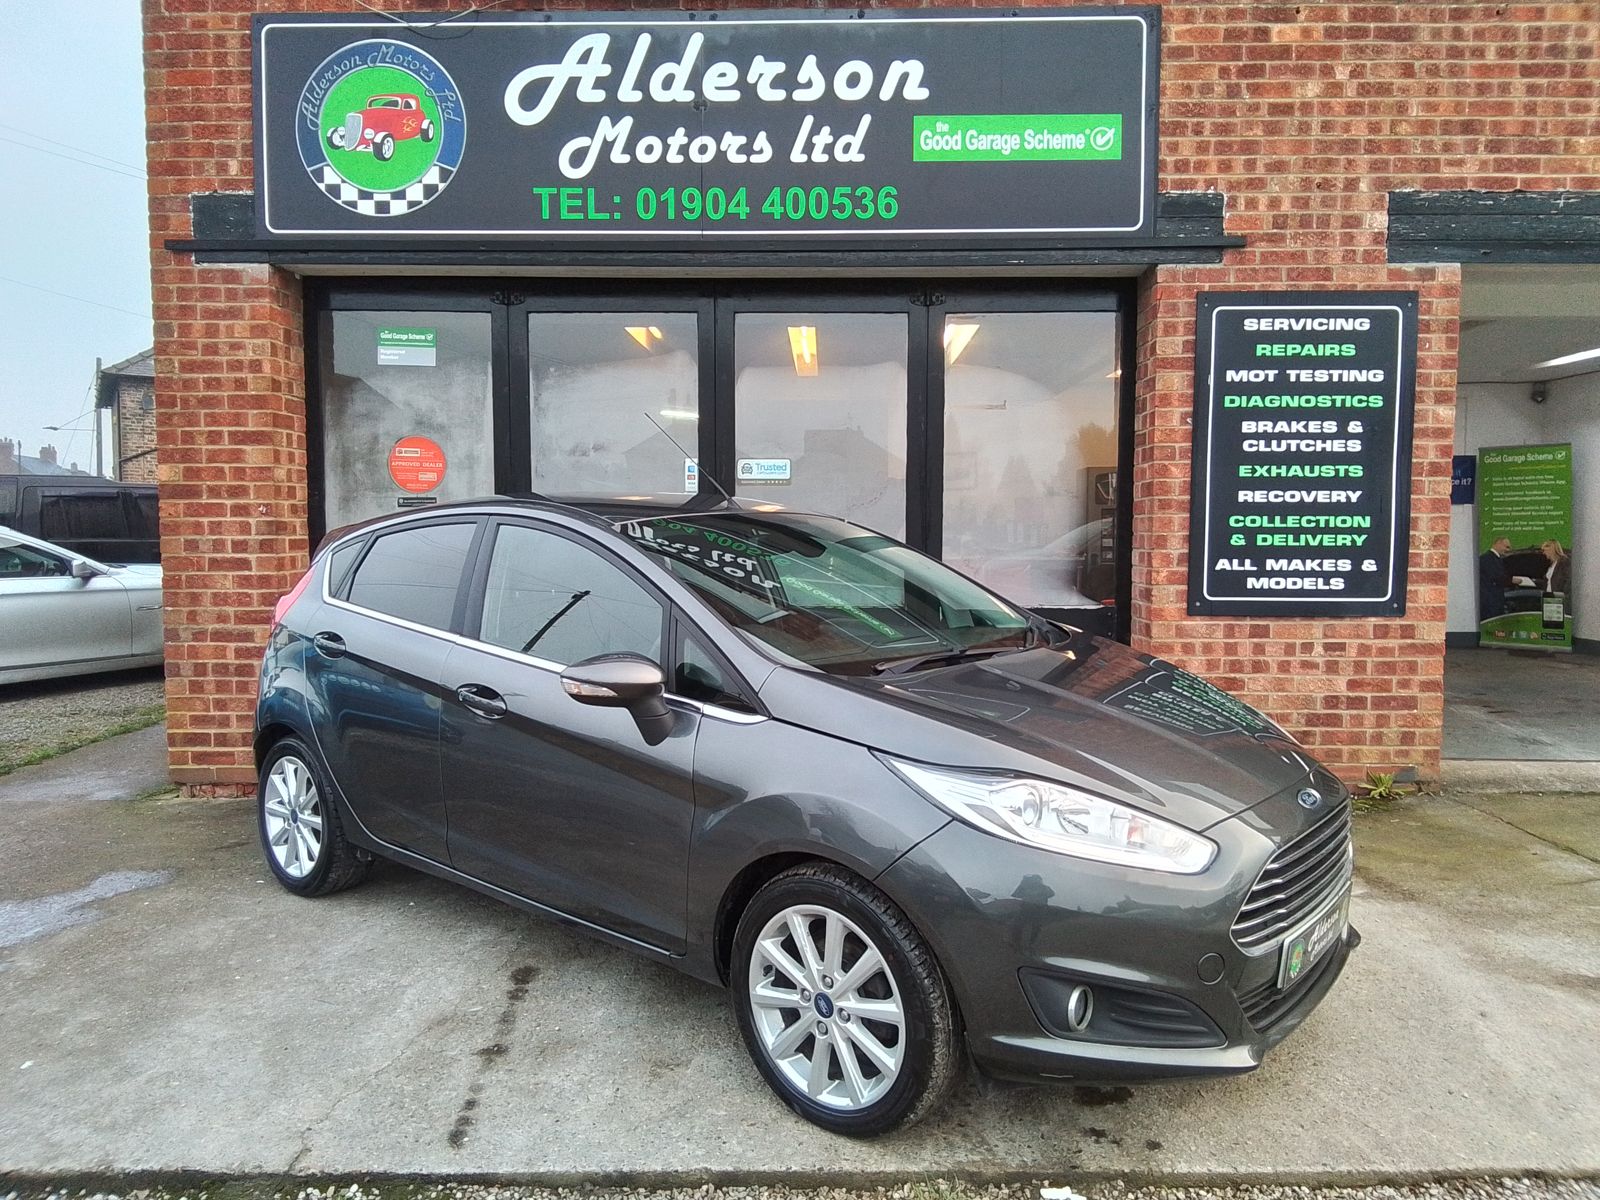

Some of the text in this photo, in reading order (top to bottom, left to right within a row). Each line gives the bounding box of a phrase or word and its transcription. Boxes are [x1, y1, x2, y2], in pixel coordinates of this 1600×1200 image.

[504, 32, 930, 126] Alderson
[301, 55, 362, 131] Alderson
[367, 44, 435, 81] Motors
[935, 121, 950, 132] the
[558, 115, 773, 179] Motors
[919, 128, 1086, 156] Good Garage Scheme
[532, 185, 899, 222] TEL: 01904 400536
[1243, 317, 1371, 331] SERVICING
[1255, 343, 1357, 357] REPAIRS
[1225, 369, 1385, 383] MOT TESTING
[1223, 394, 1385, 409] DIAGNOSTICS
[1241, 420, 1364, 434] BRAKES &
[1242, 439, 1362, 453] CLUTCHES
[755, 462, 787, 472] Trusted
[1238, 464, 1364, 478] EXHAUSTS
[1461, 477, 1472, 486] it?
[1237, 490, 1363, 503] RECOVERY
[1228, 515, 1371, 528] COLLECTION
[1229, 533, 1368, 547] & DELIVERY
[1214, 558, 1378, 572] ALL MAKES &
[1246, 577, 1345, 590] MODELS
